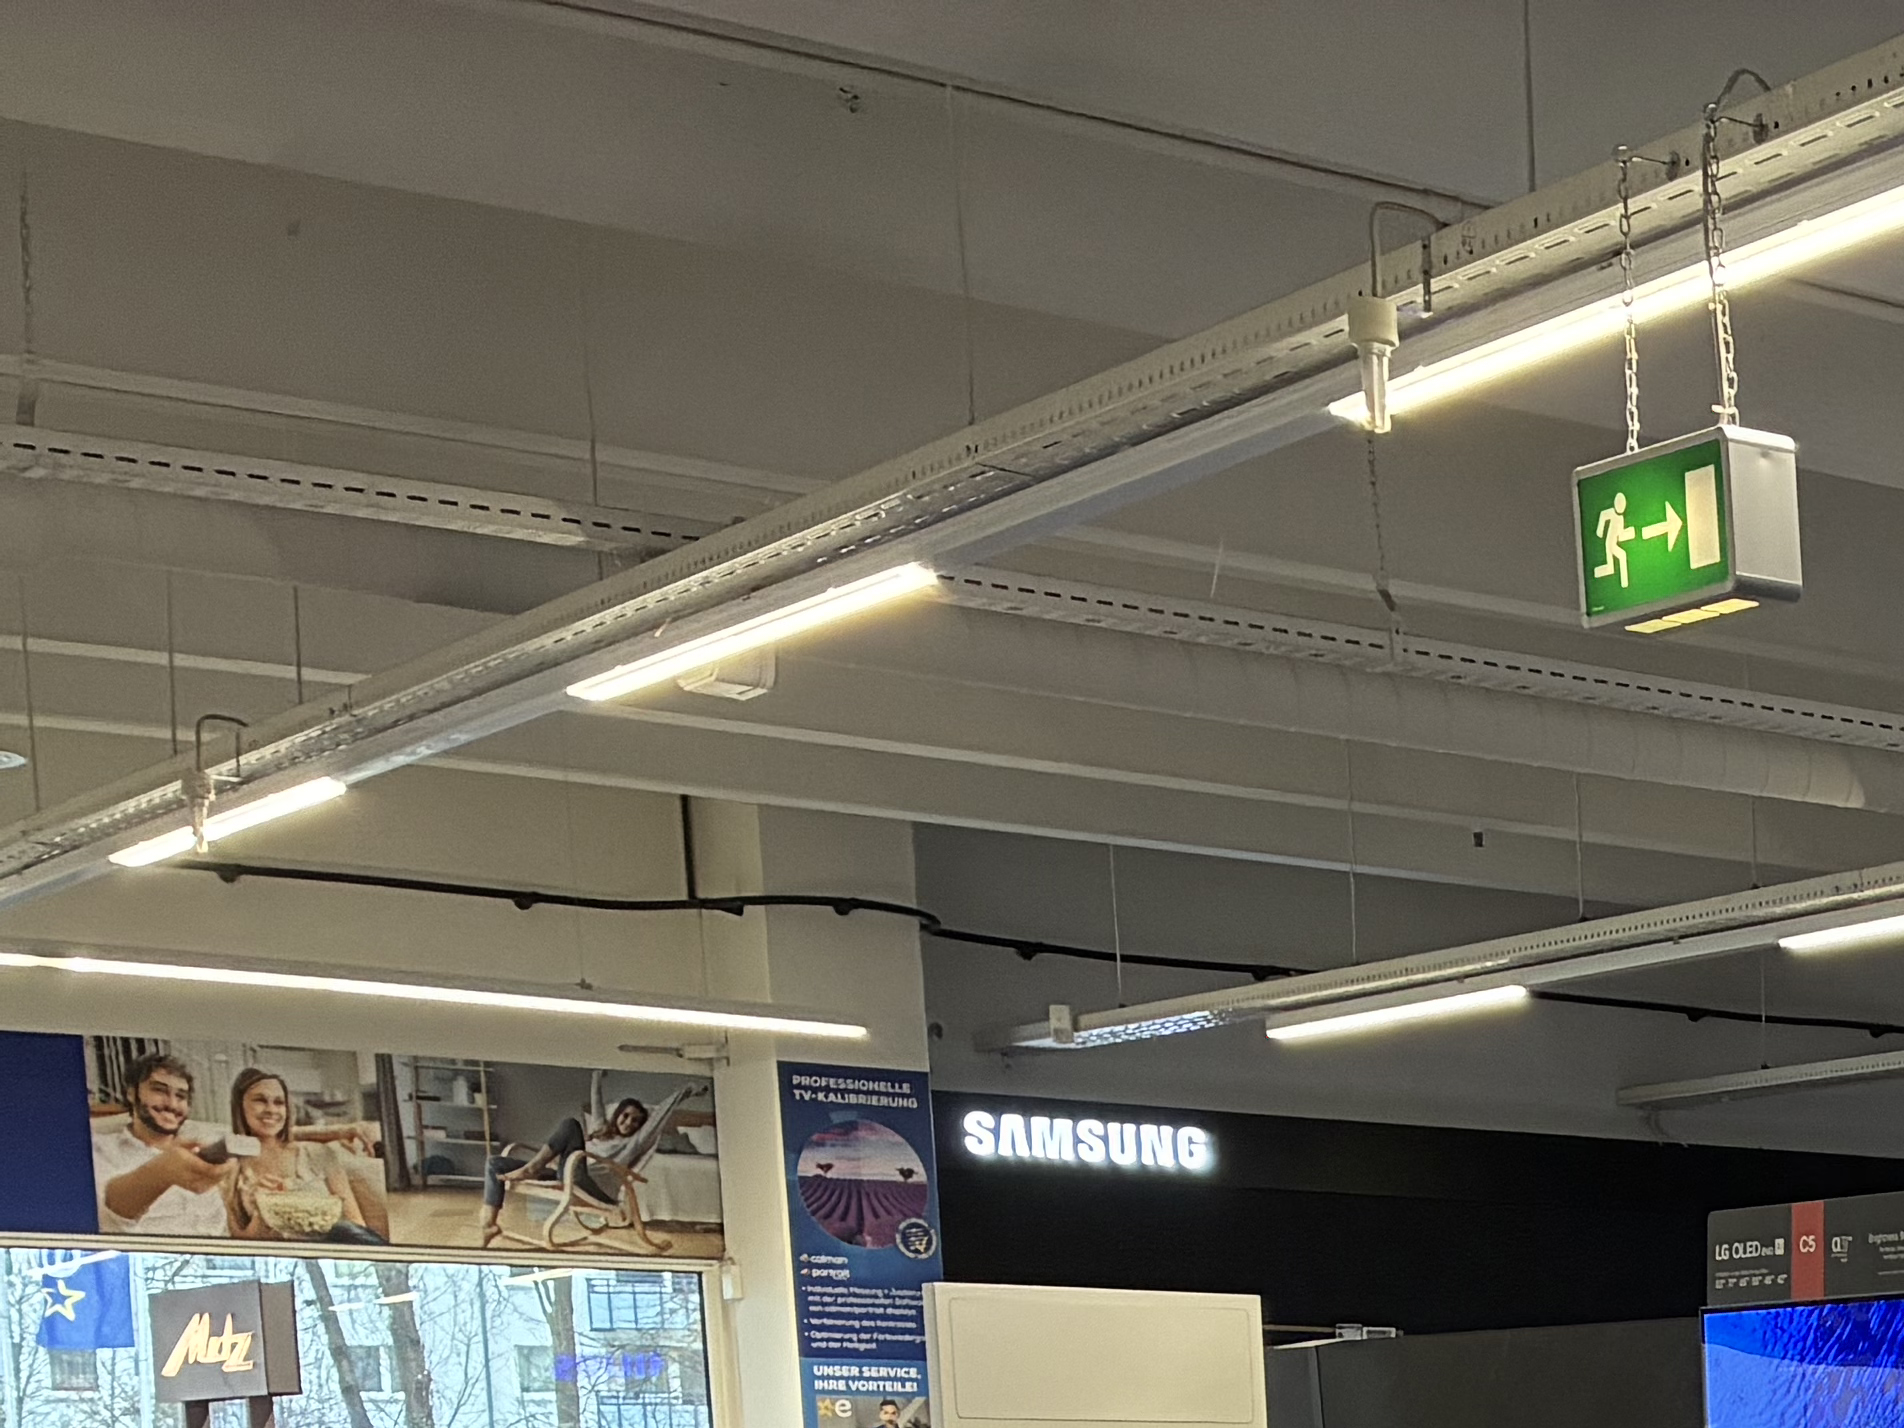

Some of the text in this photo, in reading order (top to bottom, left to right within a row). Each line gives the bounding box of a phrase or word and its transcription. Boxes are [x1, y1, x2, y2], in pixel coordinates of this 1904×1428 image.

[792, 1075, 911, 1094] PROFESSIONELLE
[793, 1089, 918, 1108] TV-KALIBRIERUNG
[963, 1111, 1212, 1170] SAMSUNG
[1716, 1241, 1761, 1261] LG OLED
[1800, 1235, 1816, 1252] C5
[161, 1312, 254, 1377] Metz
[813, 1365, 860, 1376] UNSER
